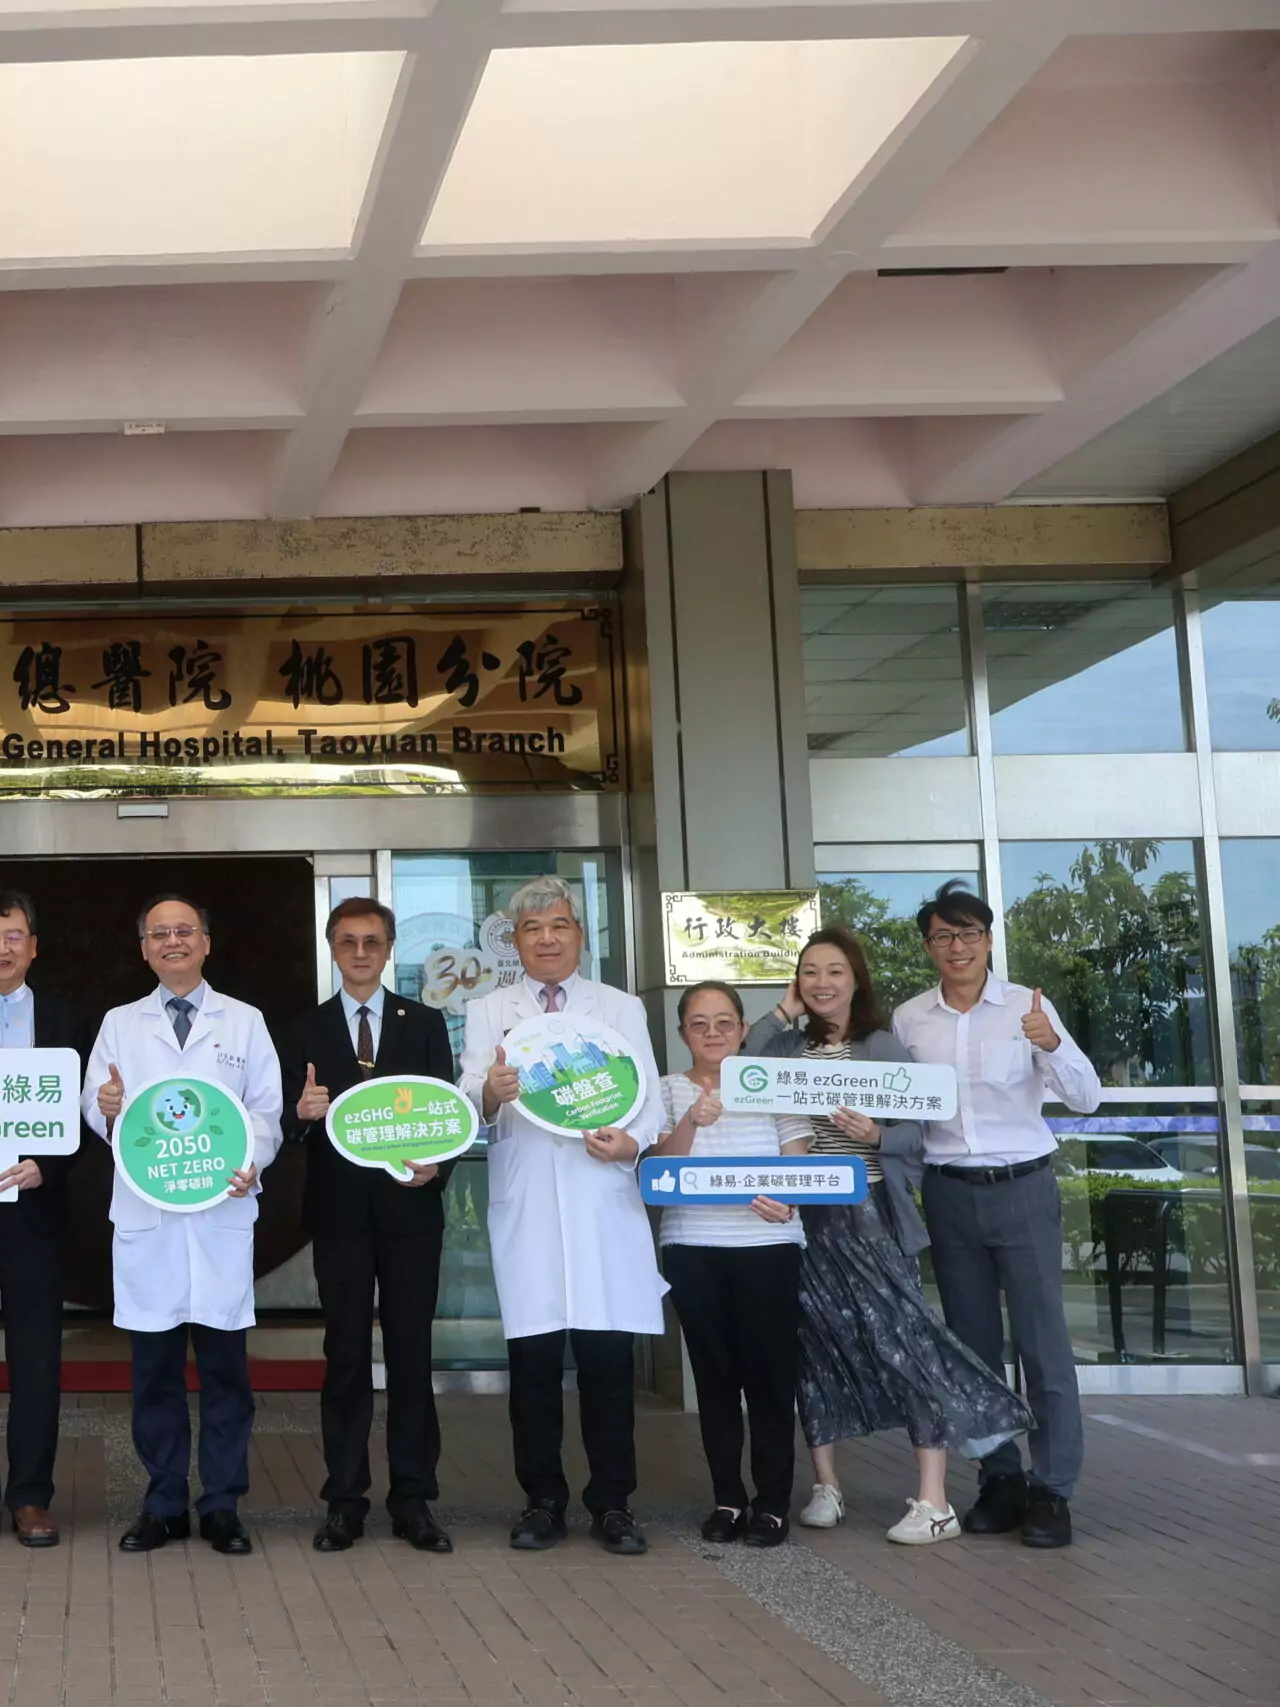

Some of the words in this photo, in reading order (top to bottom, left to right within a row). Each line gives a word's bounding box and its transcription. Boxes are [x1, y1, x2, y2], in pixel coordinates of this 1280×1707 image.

[279, 634, 583, 709] 桃園分院
[2, 732, 125, 762] General
[298, 728, 437, 760] Taoyuan
[452, 725, 565, 753] Branch
[684, 914, 803, 941] 行政大樓
[682, 949, 760, 959] Administration
[763, 949, 799, 958] Buildin
[2, 1074, 62, 1104] 綠易
[776, 1070, 808, 1085] 綠易
[813, 1074, 879, 1089] ezGreen
[344, 1107, 394, 1124] ezGHG
[412, 1098, 459, 1116] 一站式
[734, 1095, 774, 1106] ezGreen
[776, 1090, 942, 1111] 一站式碳管理解決方案
[345, 1118, 462, 1145] 碳管理解決方案
[155, 1133, 211, 1159] 2050
[147, 1163, 178, 1180] NET
[183, 1157, 226, 1175] ZERO
[163, 1176, 214, 1194] 淨零碳排
